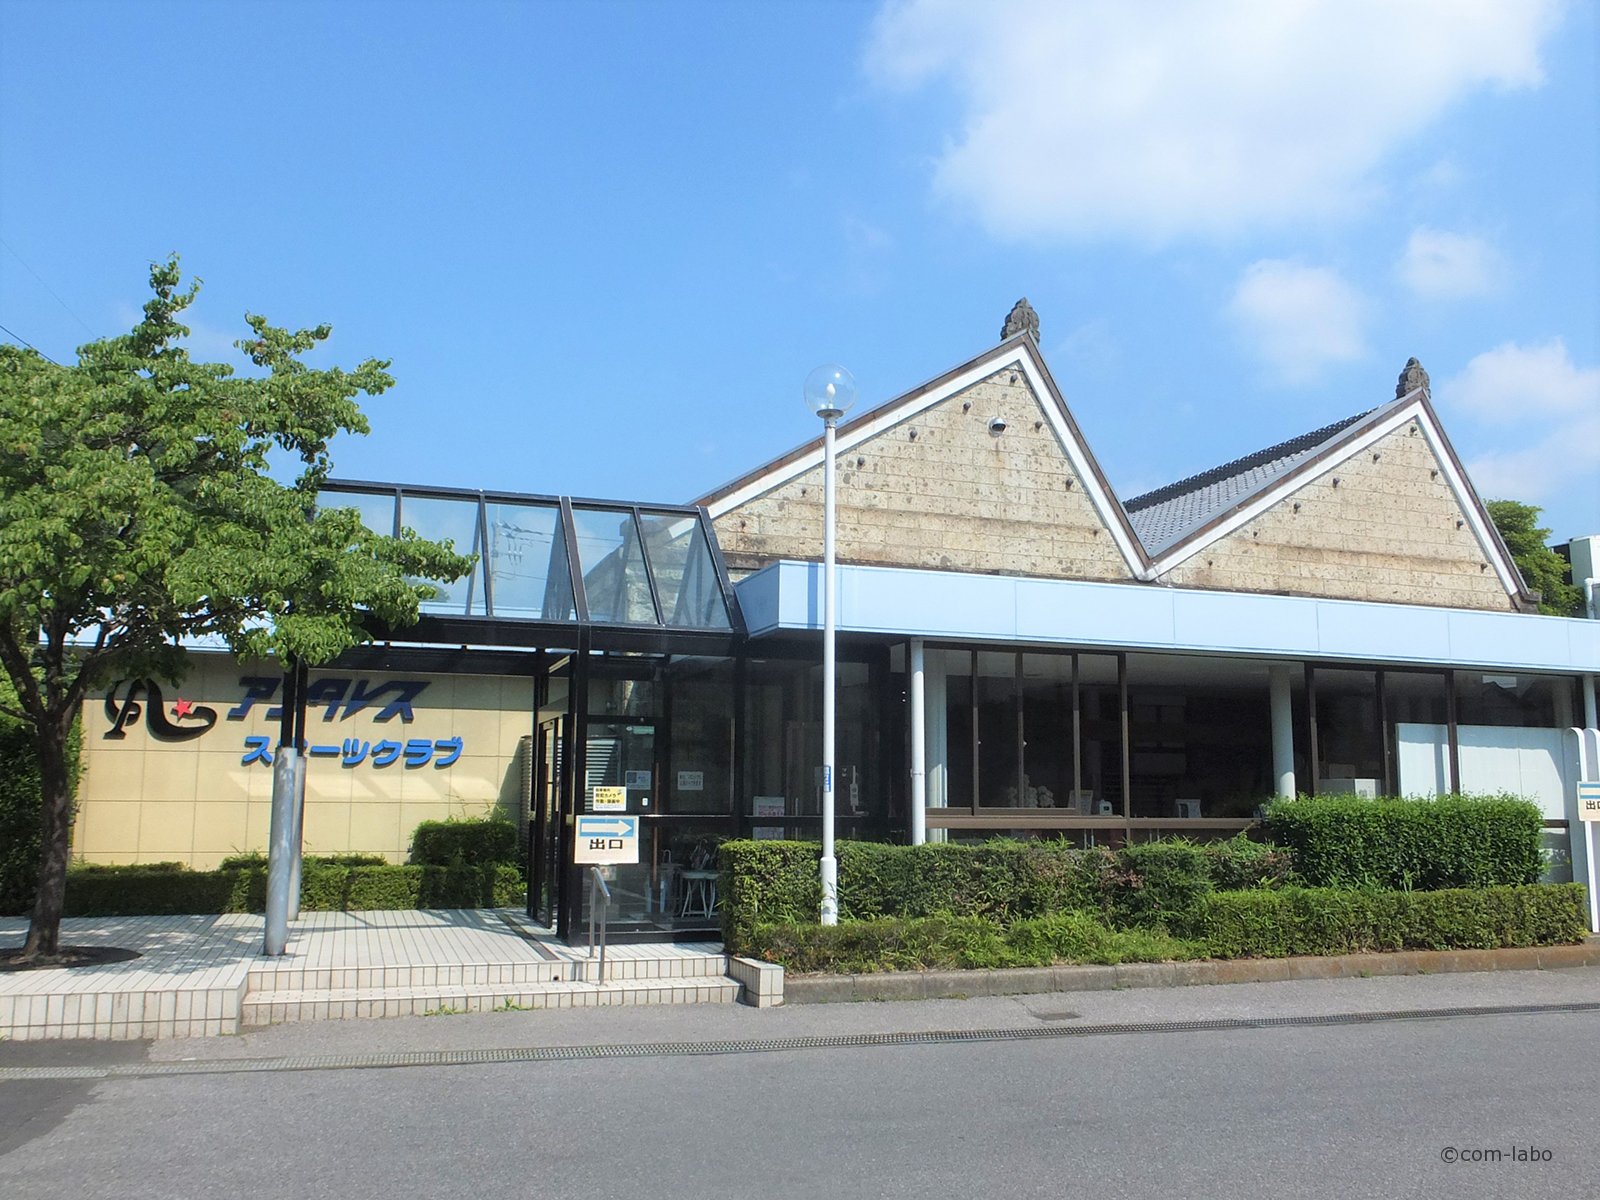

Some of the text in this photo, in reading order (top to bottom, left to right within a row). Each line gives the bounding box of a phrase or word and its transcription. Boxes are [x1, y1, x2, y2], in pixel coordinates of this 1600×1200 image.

[241, 736, 463, 767] スーツクラブ
[590, 838, 623, 850] 出口
